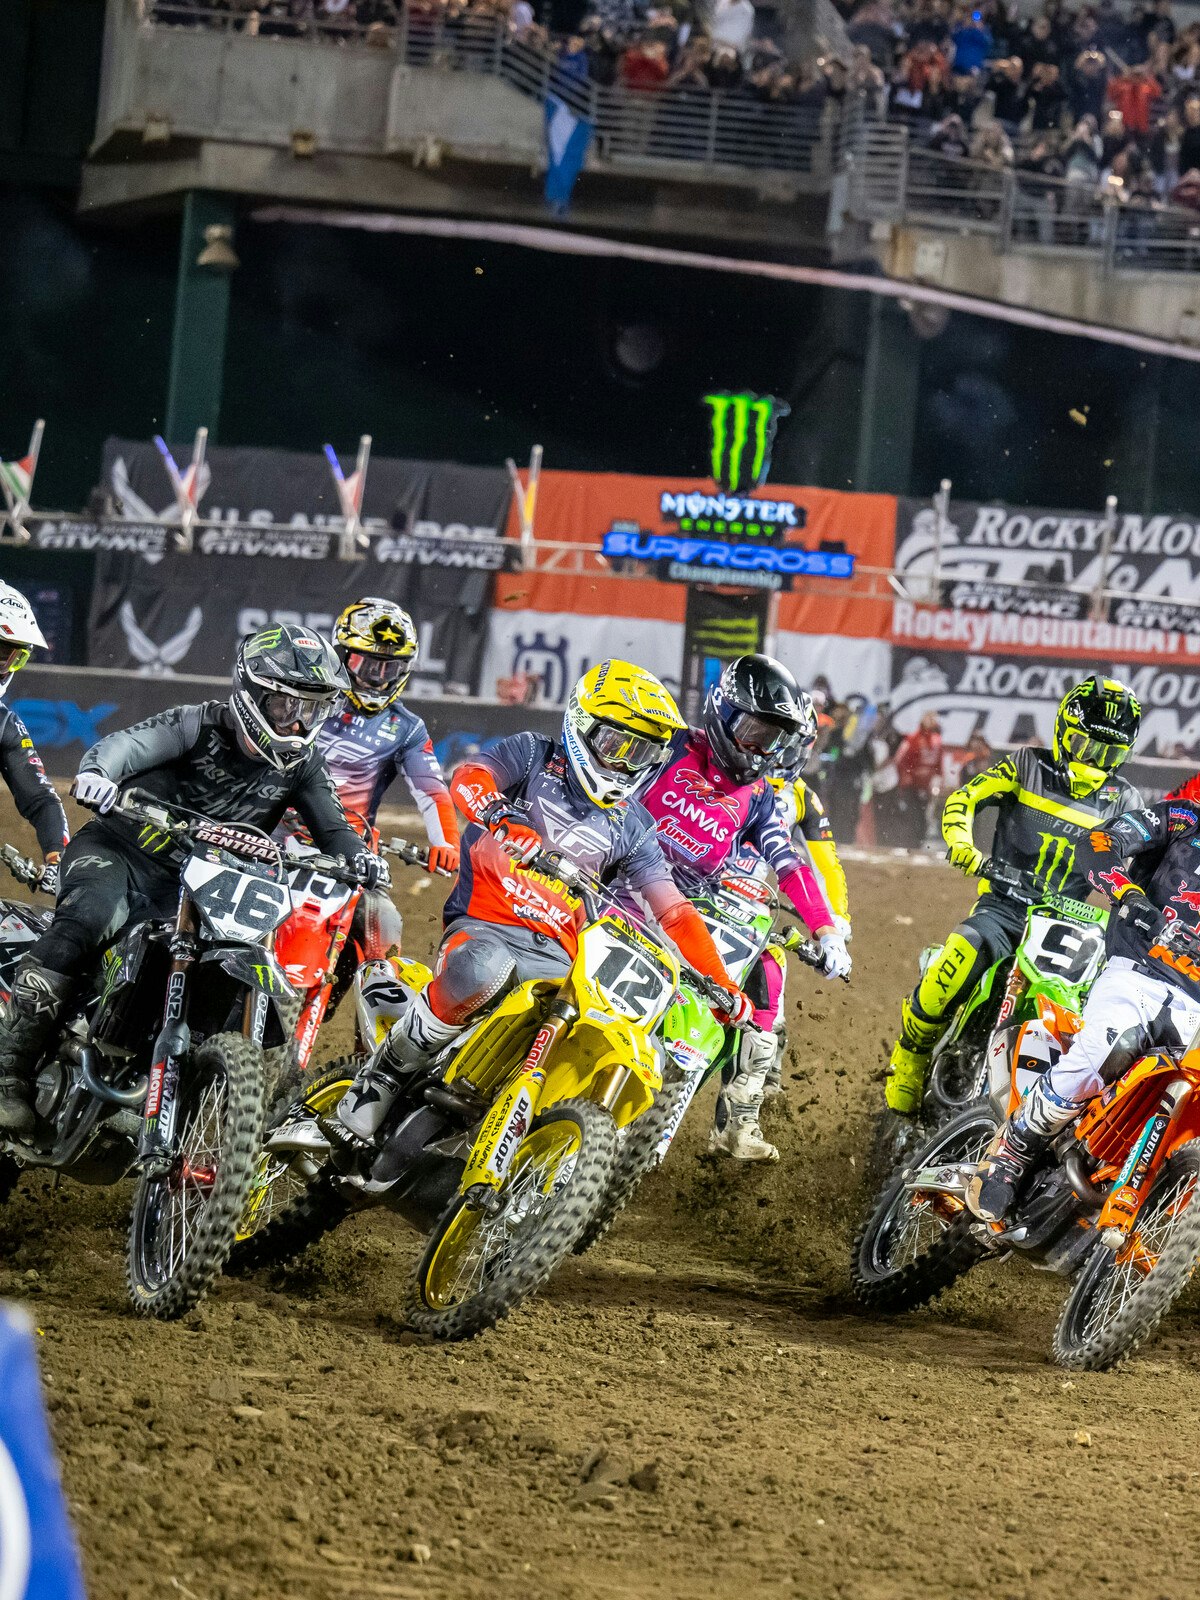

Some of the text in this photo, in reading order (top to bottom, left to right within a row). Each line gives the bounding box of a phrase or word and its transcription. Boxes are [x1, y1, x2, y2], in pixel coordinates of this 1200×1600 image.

[661, 490, 798, 526] MONSTER
[964, 507, 1113, 552] ROCKY
[233, 692, 262, 736] MONSTER
[333, 720, 382, 747] RACING
[564, 712, 589, 768] PROGRESSIVE
[656, 814, 714, 857] SUMMIT
[661, 790, 730, 842] CANVAS
[1052, 820, 1083, 839] FOX
[195, 831, 281, 861] RENTHAL
[198, 869, 286, 932] 46
[500, 875, 572, 925] SUZUKI
[564, 885, 583, 912] TEA
[935, 947, 966, 994] FOX
[1036, 922, 1099, 984] 9
[591, 945, 664, 1017] 12
[146, 1067, 163, 1115] MOTUL
[494, 1097, 530, 1173] DUNLOP
[1111, 1202, 1134, 1218] KTM
